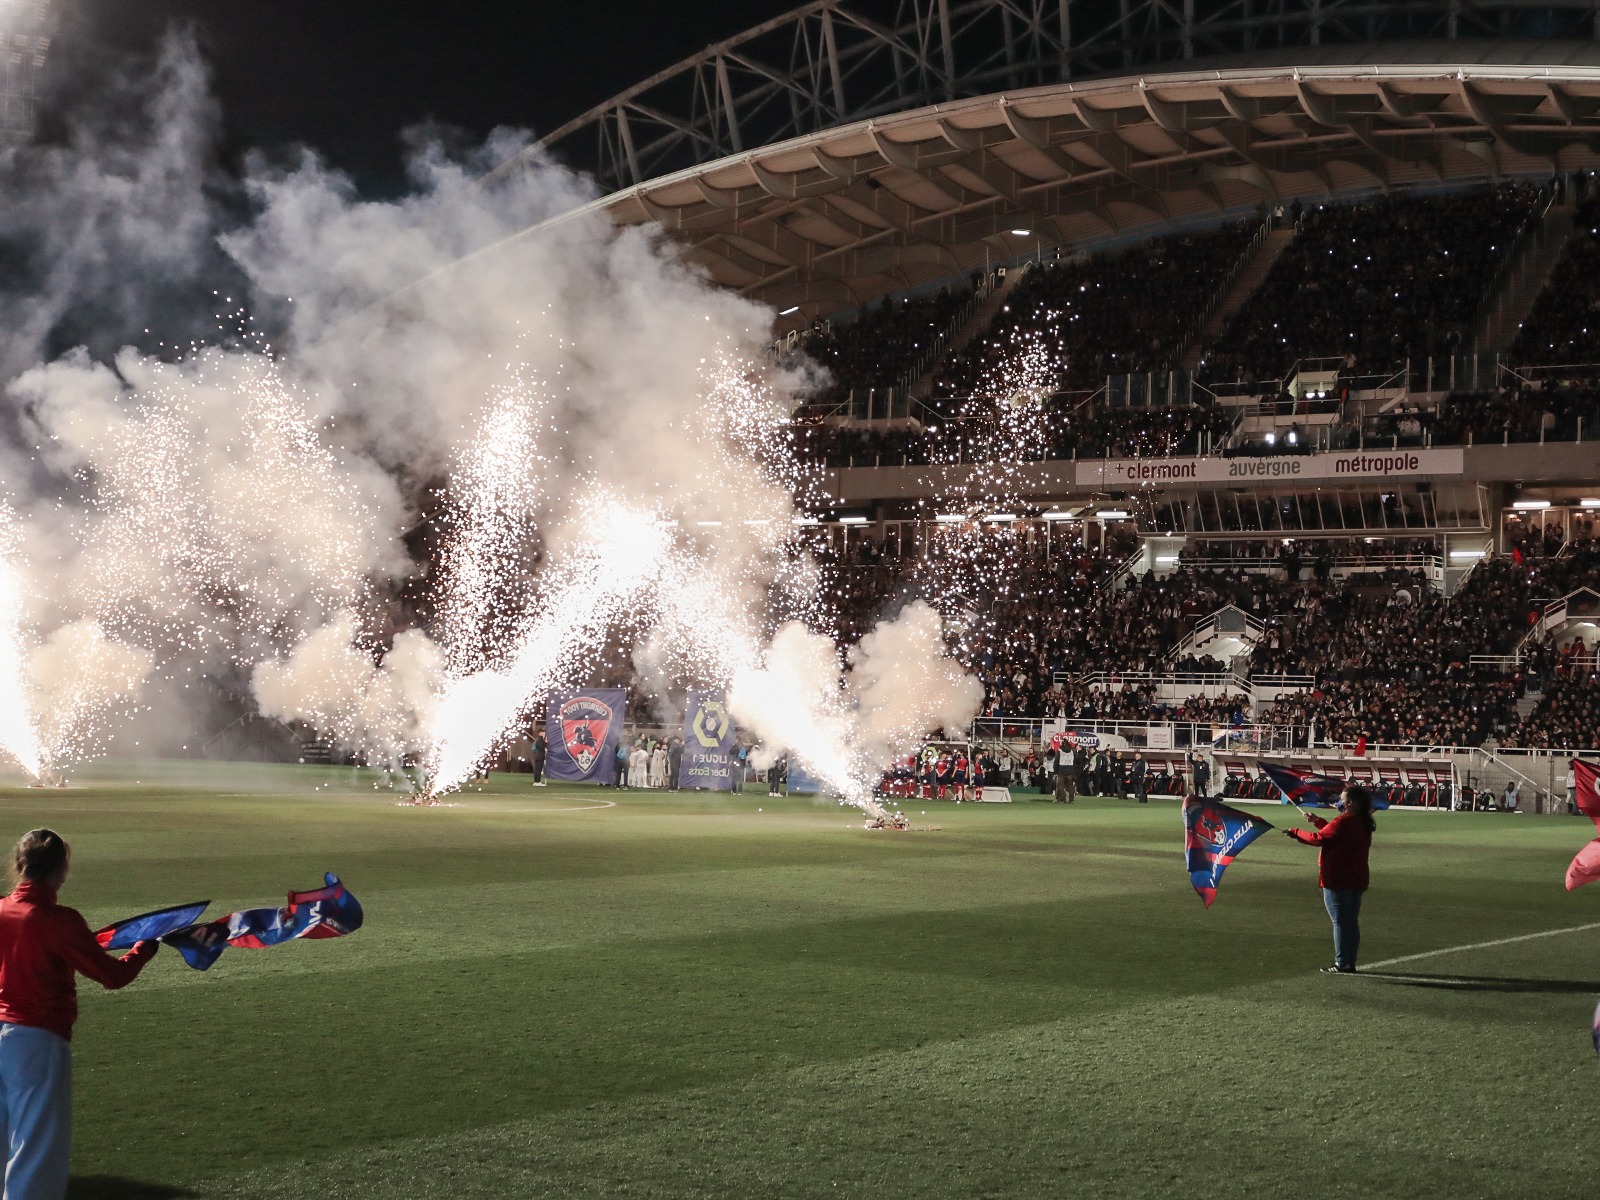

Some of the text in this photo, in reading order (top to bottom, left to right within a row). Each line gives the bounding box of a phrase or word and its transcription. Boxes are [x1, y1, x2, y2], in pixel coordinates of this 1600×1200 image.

[1127, 453, 1419, 479] clermont auvergne métropole
